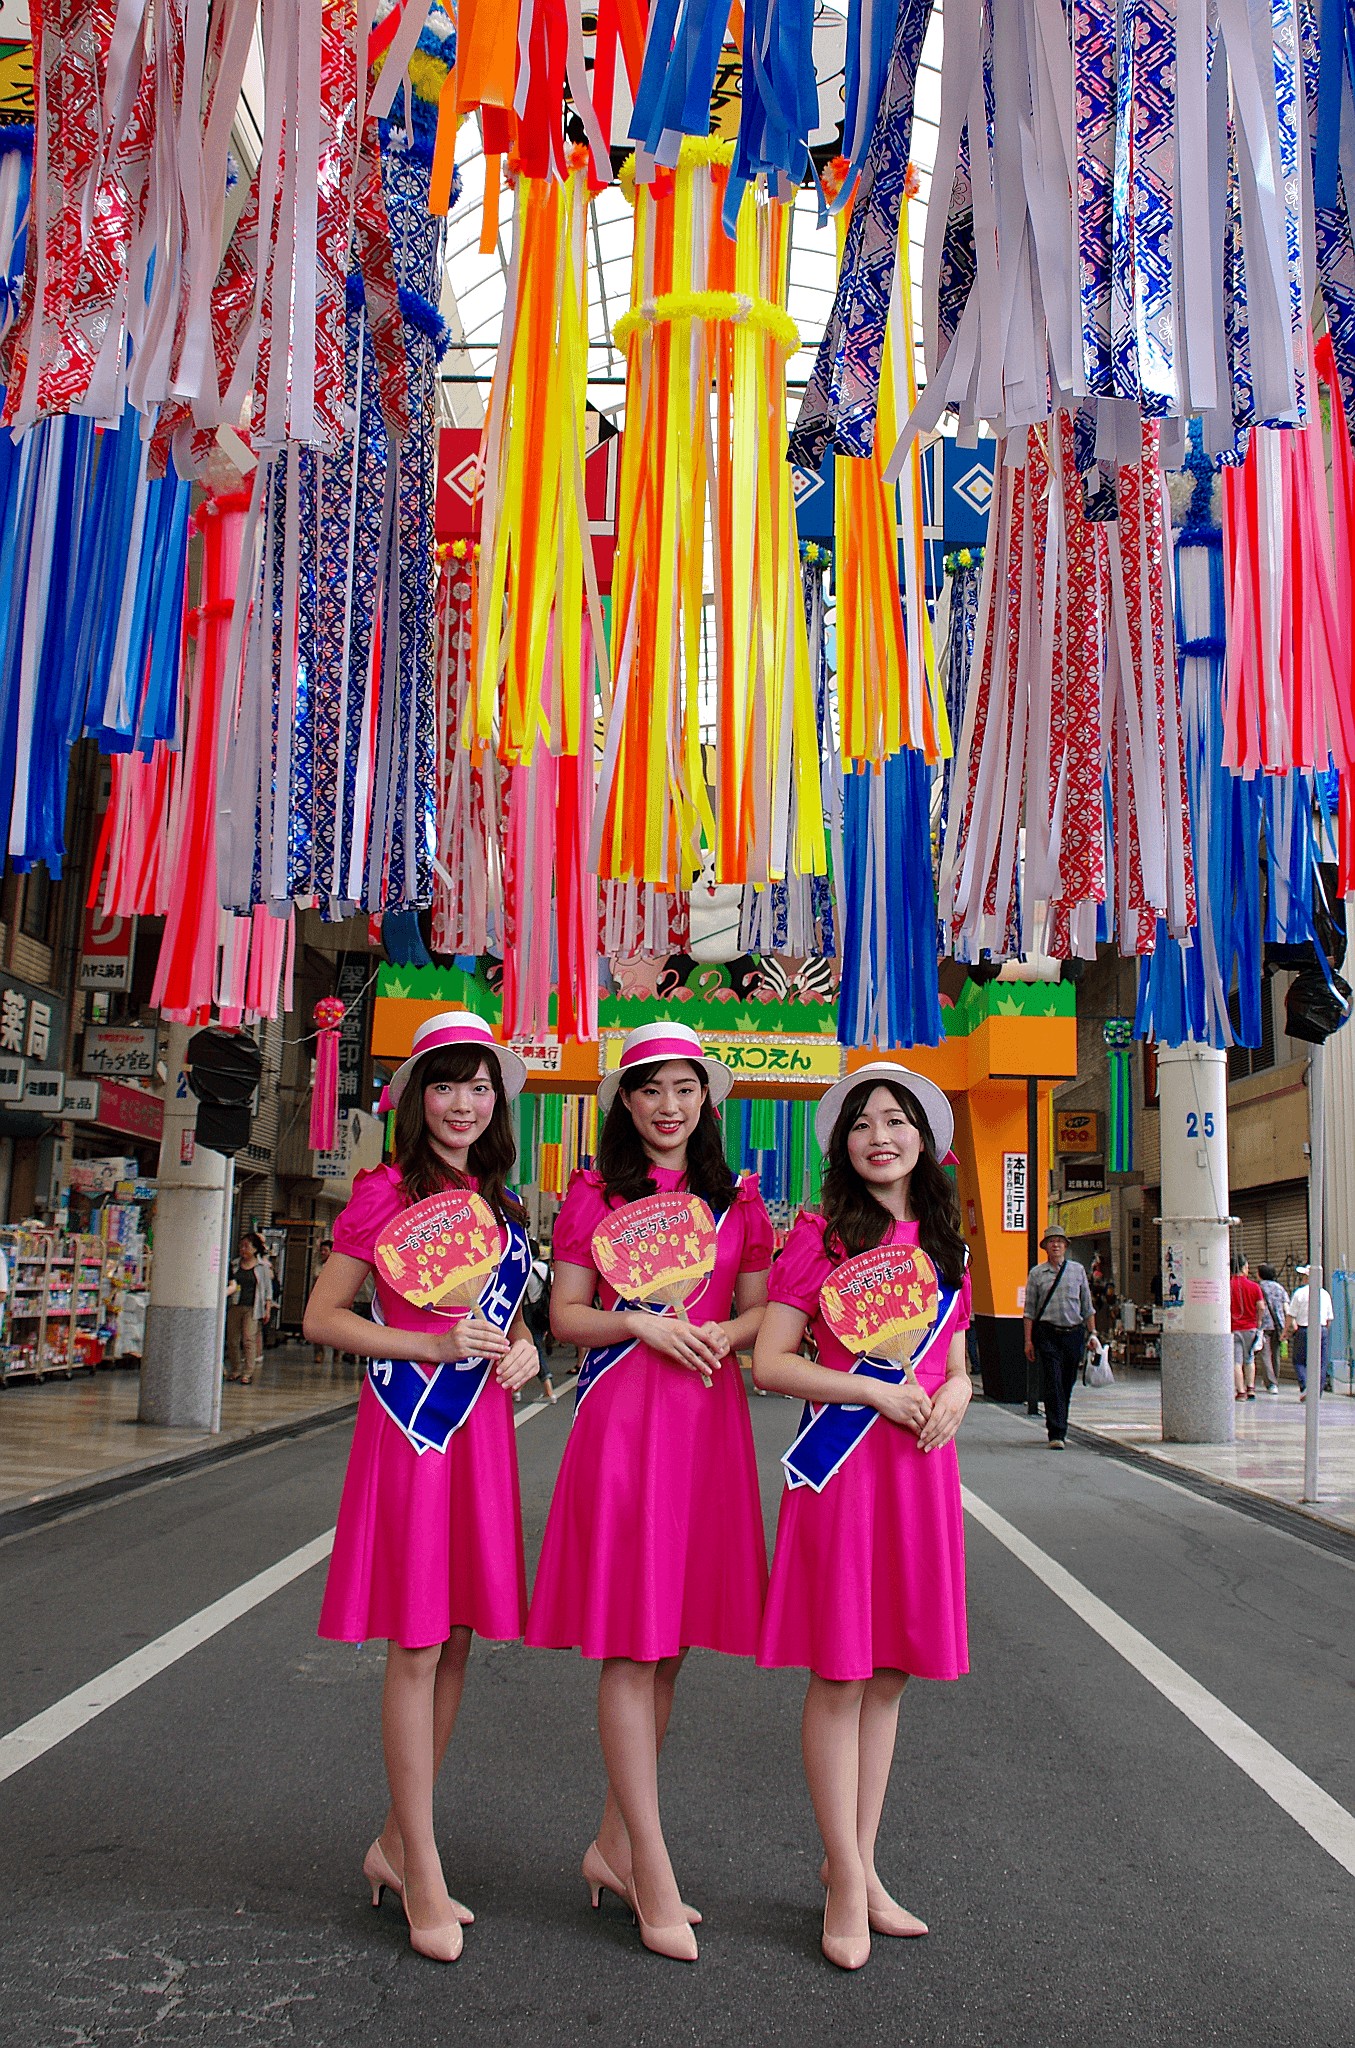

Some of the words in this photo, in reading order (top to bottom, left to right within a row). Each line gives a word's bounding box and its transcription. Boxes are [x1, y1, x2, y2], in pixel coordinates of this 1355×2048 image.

[1, 989, 50, 1061] 薬局
[542, 1060, 558, 1070] です
[1186, 1112, 1215, 1138] 25
[1013, 1157, 1026, 1228] 本町三丁目
[397, 1206, 471, 1252] 一宮七夕まつり
[611, 1209, 690, 1246] 一宮七夕まつり
[839, 1259, 914, 1297] 一宮七夕まつり
